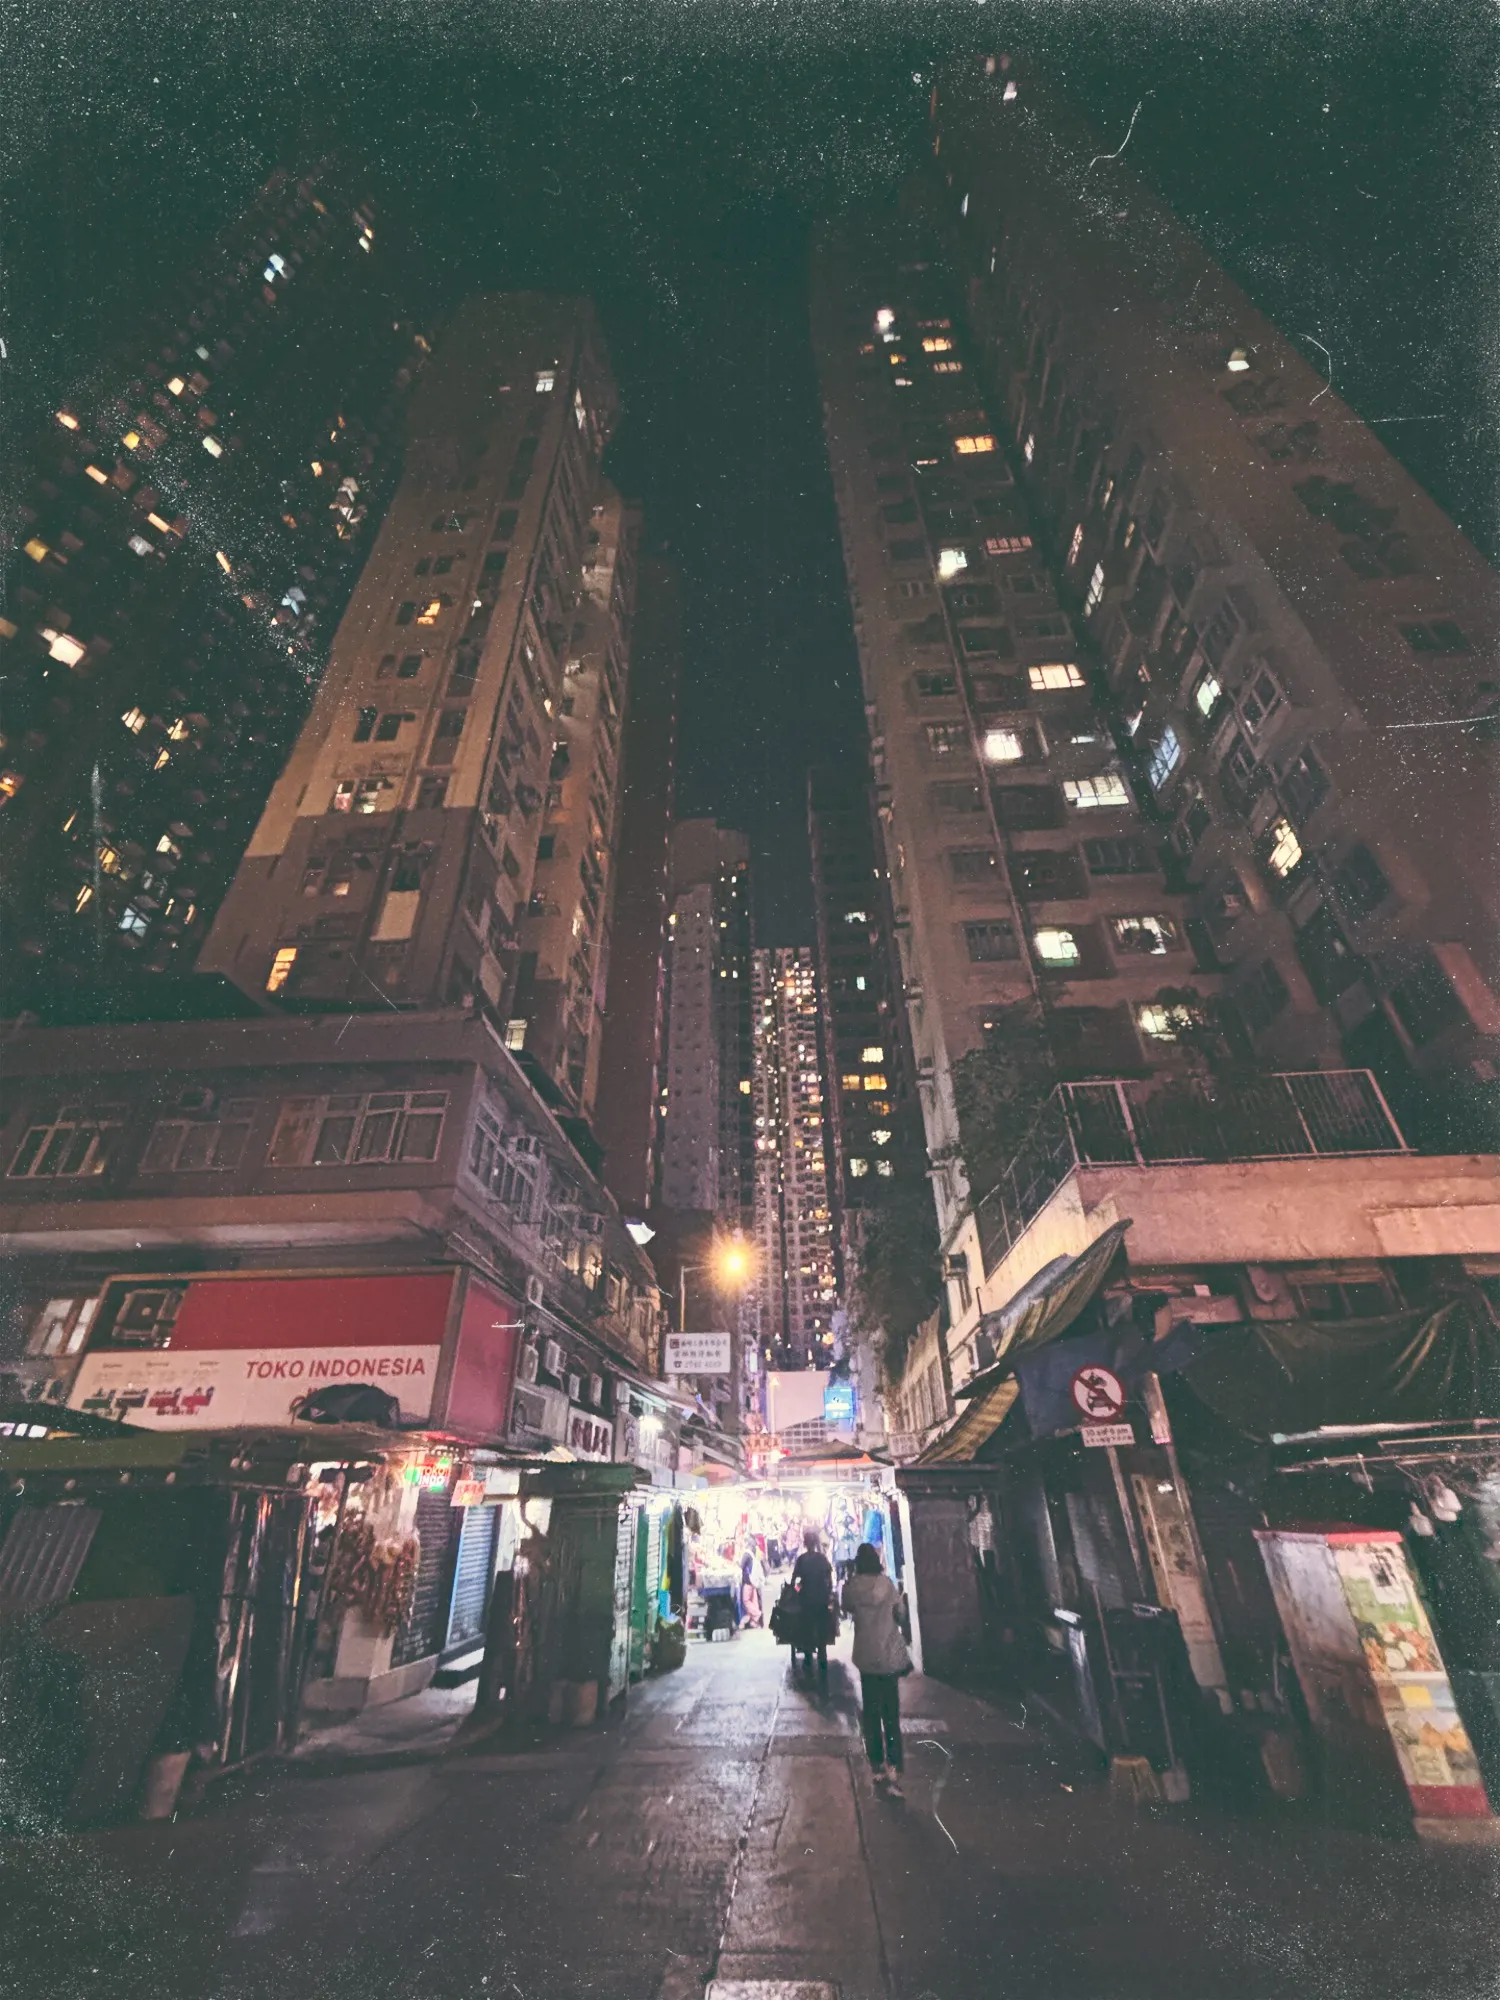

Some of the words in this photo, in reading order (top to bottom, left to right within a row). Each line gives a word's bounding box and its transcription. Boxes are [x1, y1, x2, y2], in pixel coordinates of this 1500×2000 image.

[246, 1359, 304, 1379] TOKO
[308, 1358, 426, 1377] INDONESIA
[421, 1467, 445, 1476] TOKO
[419, 1475, 445, 1485] INDO
